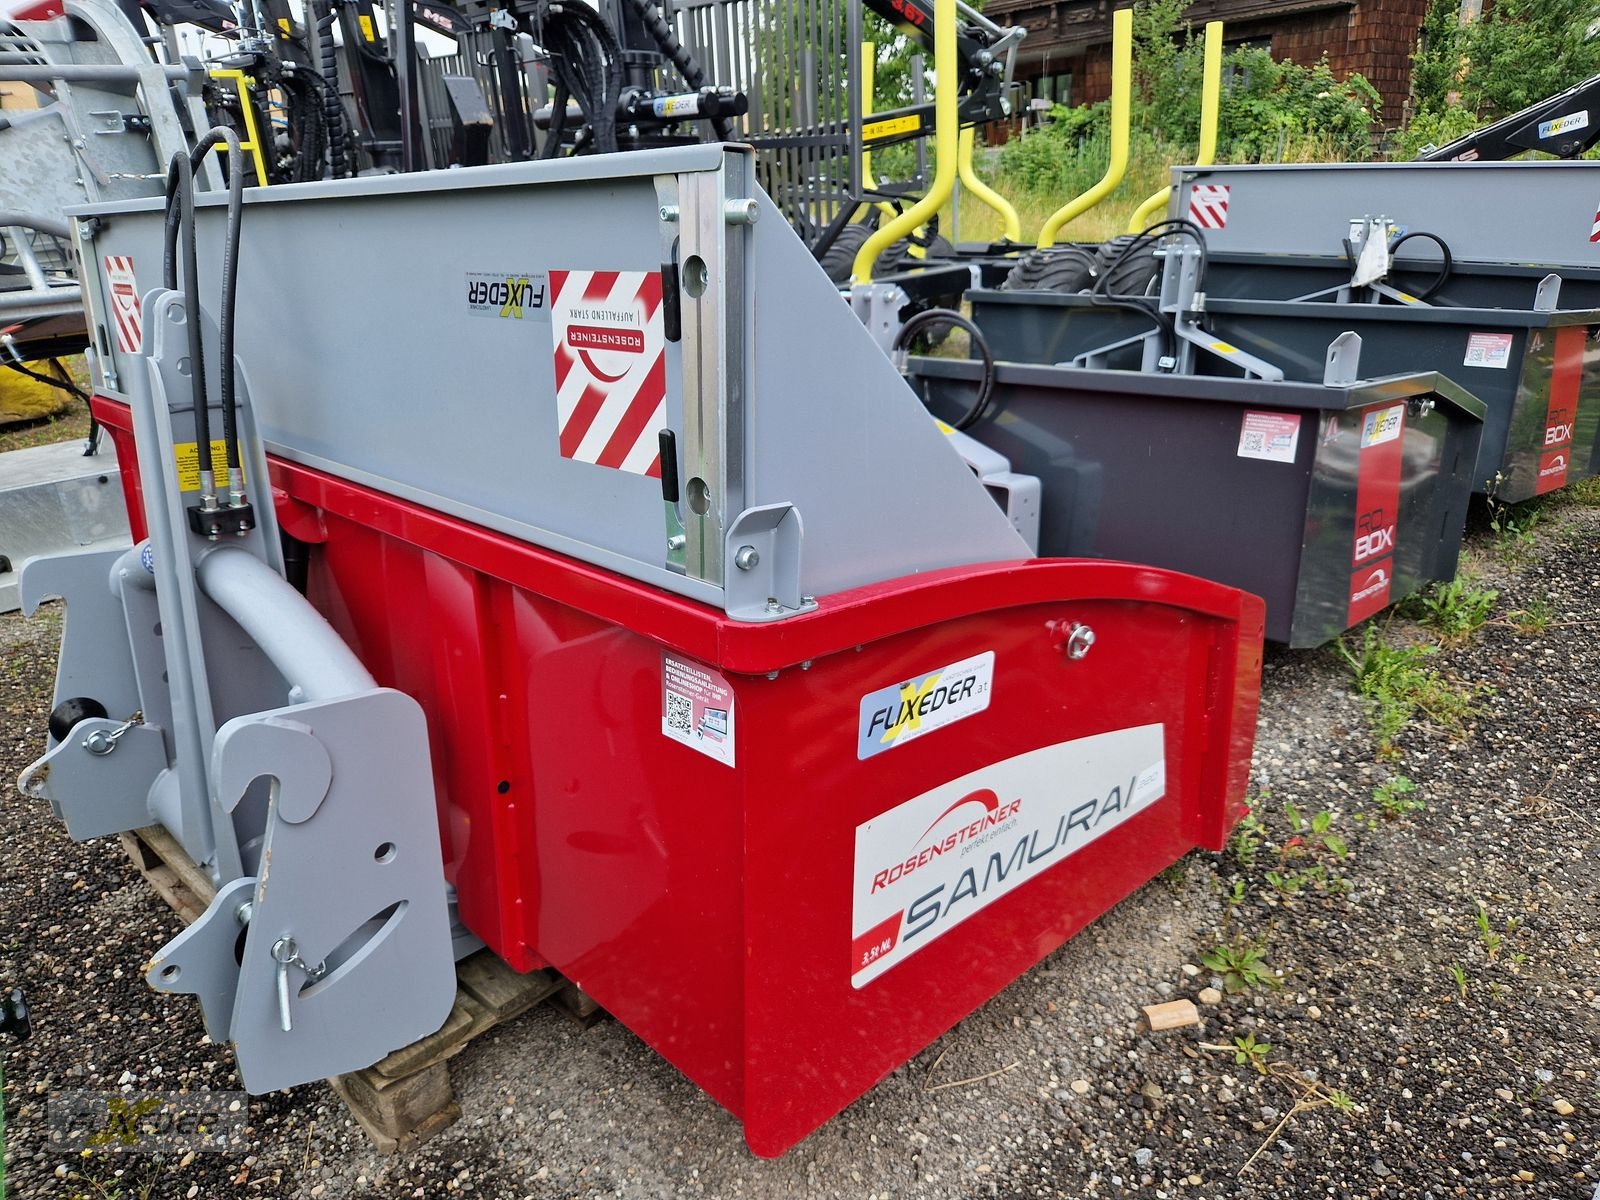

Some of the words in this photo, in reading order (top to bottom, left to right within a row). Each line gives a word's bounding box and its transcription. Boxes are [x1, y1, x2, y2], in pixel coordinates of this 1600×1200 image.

[1542, 117, 1581, 135] FLIXEDER
[468, 279, 545, 311] FLIXEDER
[569, 308, 589, 320] STARK
[592, 310, 634, 321] AUFFALLEND
[570, 331, 641, 347] ROSENSTEINER
[1366, 416, 1398, 437] FLIXEDER
[1545, 423, 1573, 444] BOX
[1358, 509, 1383, 532] RO
[1355, 525, 1394, 560] BOX
[666, 665, 728, 697] BEDIENUNGSANLEITUNG
[671, 675, 703, 692] ONLINESHOP
[870, 798, 1022, 895] ROSENSTEINER
[960, 831, 989, 858] perfekt
[902, 776, 1136, 943] SAMURAI
